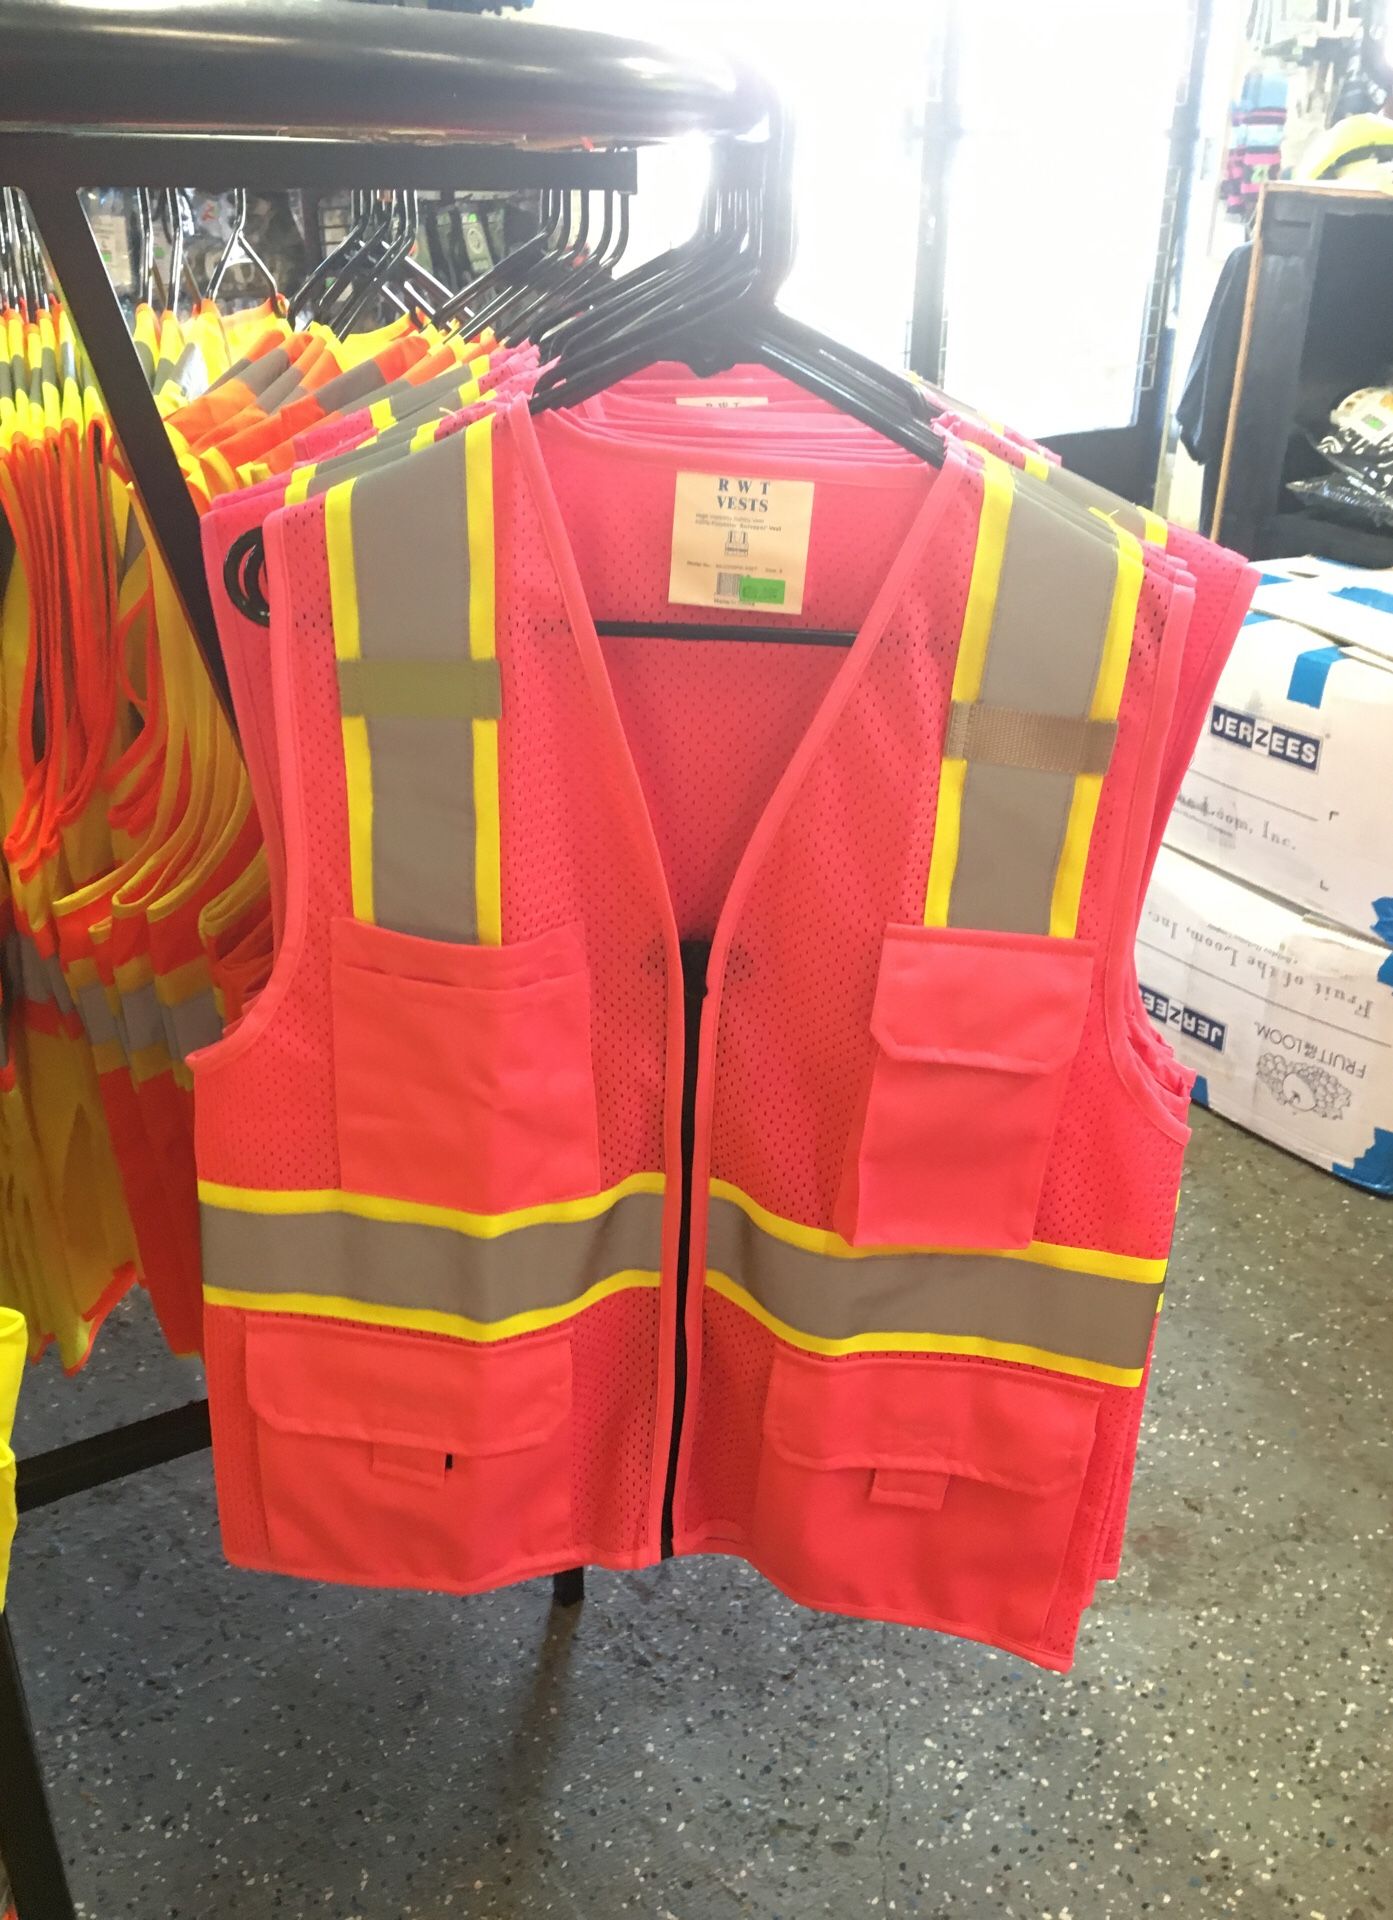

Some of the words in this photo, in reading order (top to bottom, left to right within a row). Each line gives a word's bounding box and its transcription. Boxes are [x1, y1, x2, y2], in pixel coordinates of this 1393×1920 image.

[717, 495, 769, 513] VESTS
[1214, 713, 1316, 764] JERZEES
[1262, 820, 1296, 850] Inc.
[1186, 926, 1239, 967] Loom,
[1247, 955, 1280, 980] the
[1282, 970, 1304, 988] of
[1315, 981, 1374, 1018] Fruit
[1139, 991, 1222, 1042] JERZEE
[1317, 1049, 1367, 1079] FRUIT
